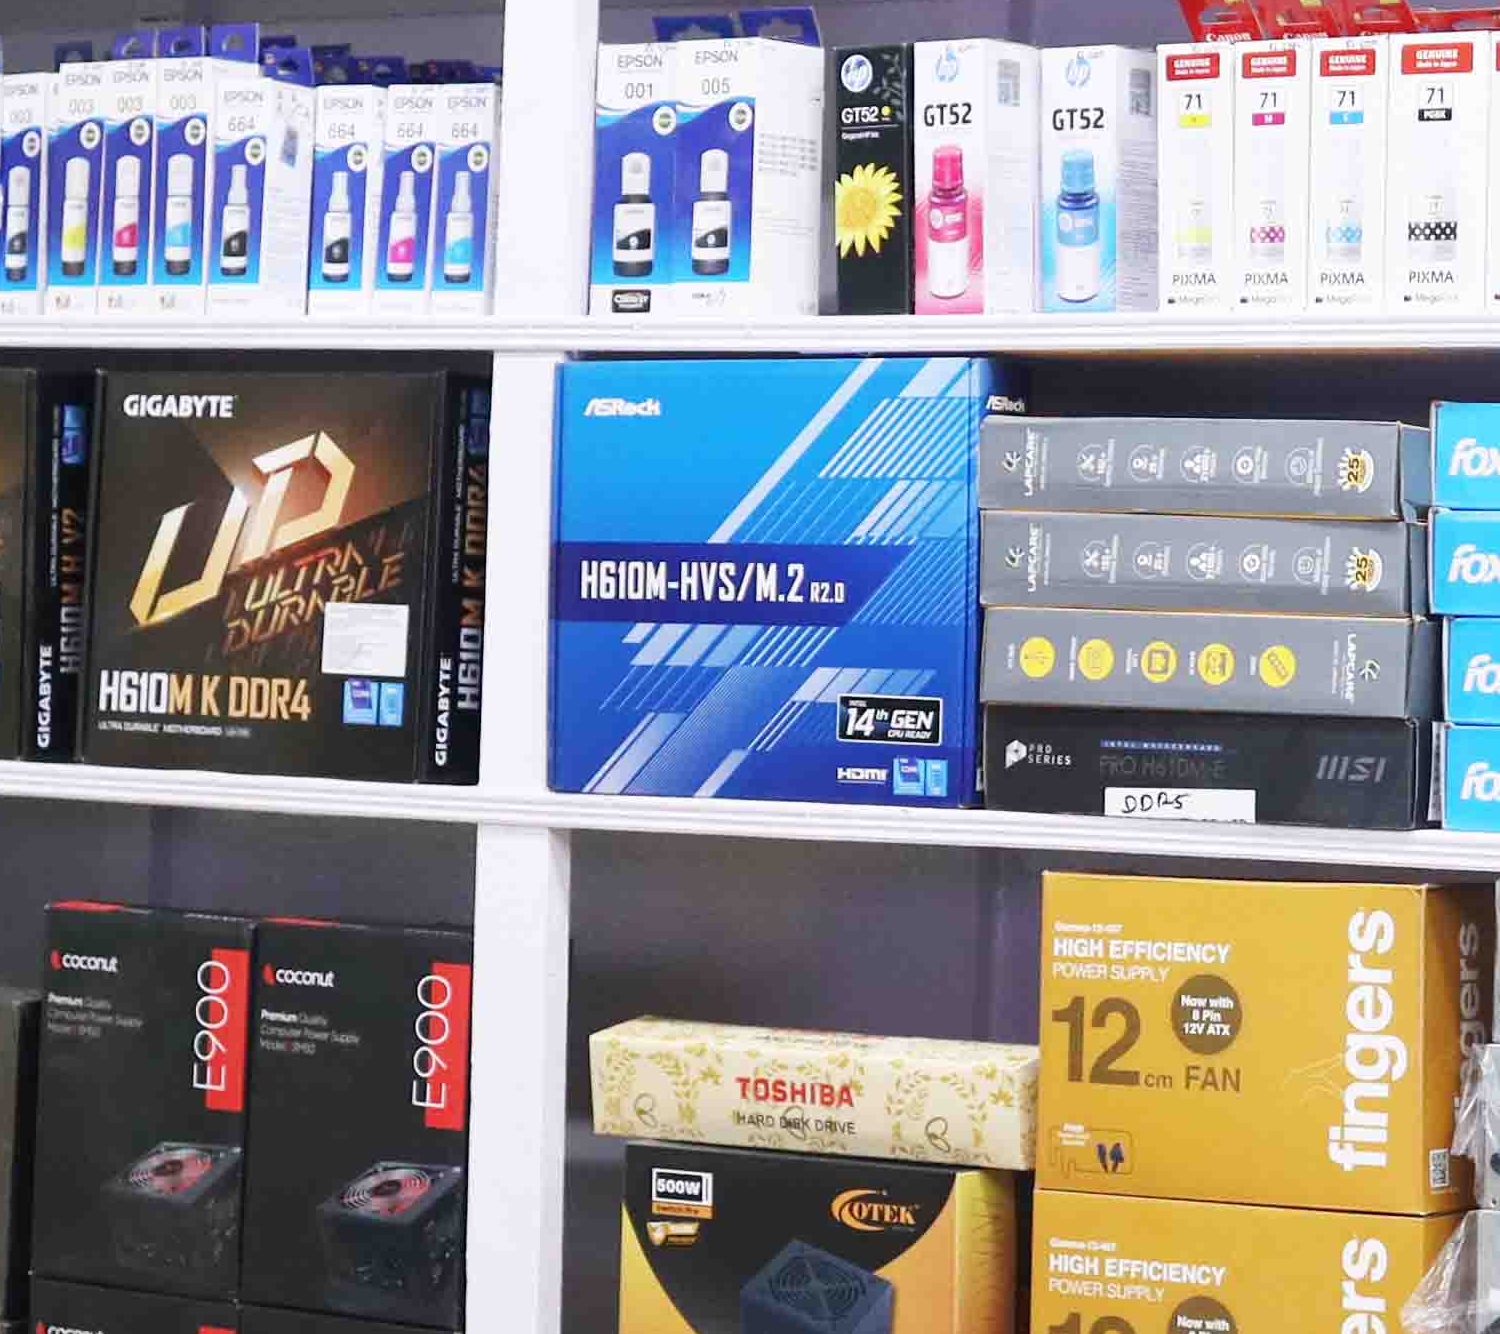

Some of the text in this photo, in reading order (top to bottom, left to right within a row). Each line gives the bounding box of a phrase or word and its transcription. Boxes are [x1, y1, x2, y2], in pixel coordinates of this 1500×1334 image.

[617, 54, 663, 68] EPSON
[695, 50, 739, 64] EPSON
[624, 82, 654, 99] 001
[701, 77, 730, 94] 005
[1184, 94, 1203, 109] 71
[1260, 92, 1277, 108] 71
[1338, 90, 1357, 107] 71
[841, 106, 880, 124] GT52
[923, 103, 972, 127] GT52
[1052, 107, 1105, 131] GT52
[1172, 273, 1216, 286] PIXMA
[1245, 273, 1288, 285] PIXMA
[1320, 273, 1365, 285] PIXMA
[123, 394, 235, 418] GIGABYTE
[585, 397, 660, 417] ASRock
[581, 561, 845, 603] H610M-HVS/M.2 R2.0
[99, 670, 311, 721] H610M K DDR4
[891, 710, 934, 730] GEN
[1028, 753, 1071, 766] SERIES
[1053, 938, 1230, 964] HIGH EFFICIENCY
[62, 953, 119, 973] coconut
[1052, 962, 1171, 983] POWER SUPPLY
[275, 969, 334, 988] coconut
[1181, 995, 1234, 1009] Now with
[1202, 1009, 1221, 1021] Pin
[193, 960, 231, 1092] E900
[1182, 1023, 1230, 1036] 12V ATX
[412, 975, 453, 1110] E900
[1052, 996, 1241, 1093] 12 cm FAN
[1328, 907, 1408, 1172] fingers
[736, 1076, 854, 1107] TOSHIBA
[737, 1112, 775, 1128] HARD
[814, 1119, 857, 1136] DRIVE
[656, 1178, 702, 1196] 500W
[1049, 1253, 1226, 1287] HIGH EFFICIENCY
[1049, 1278, 1165, 1303] POWER SUPPLY
